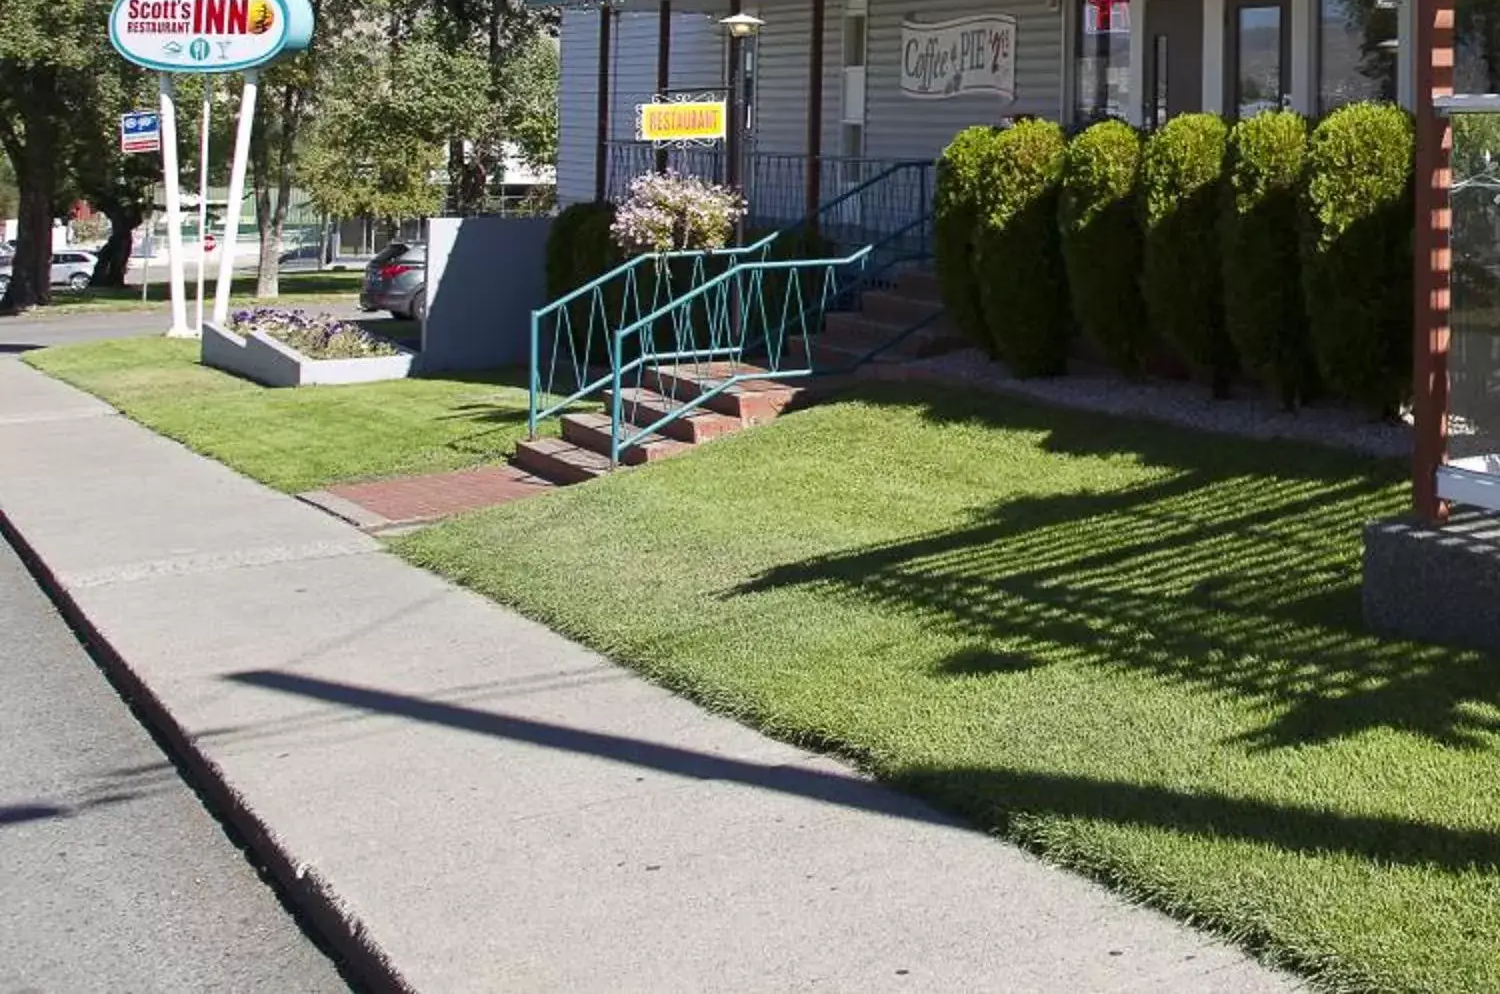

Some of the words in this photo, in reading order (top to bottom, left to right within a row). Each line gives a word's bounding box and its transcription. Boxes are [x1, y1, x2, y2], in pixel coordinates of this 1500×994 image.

[127, 21, 190, 34] RESTAURANT
[905, 37, 948, 91] Coffee
[960, 29, 987, 72] PIE
[650, 110, 718, 132] RESTAURANT
